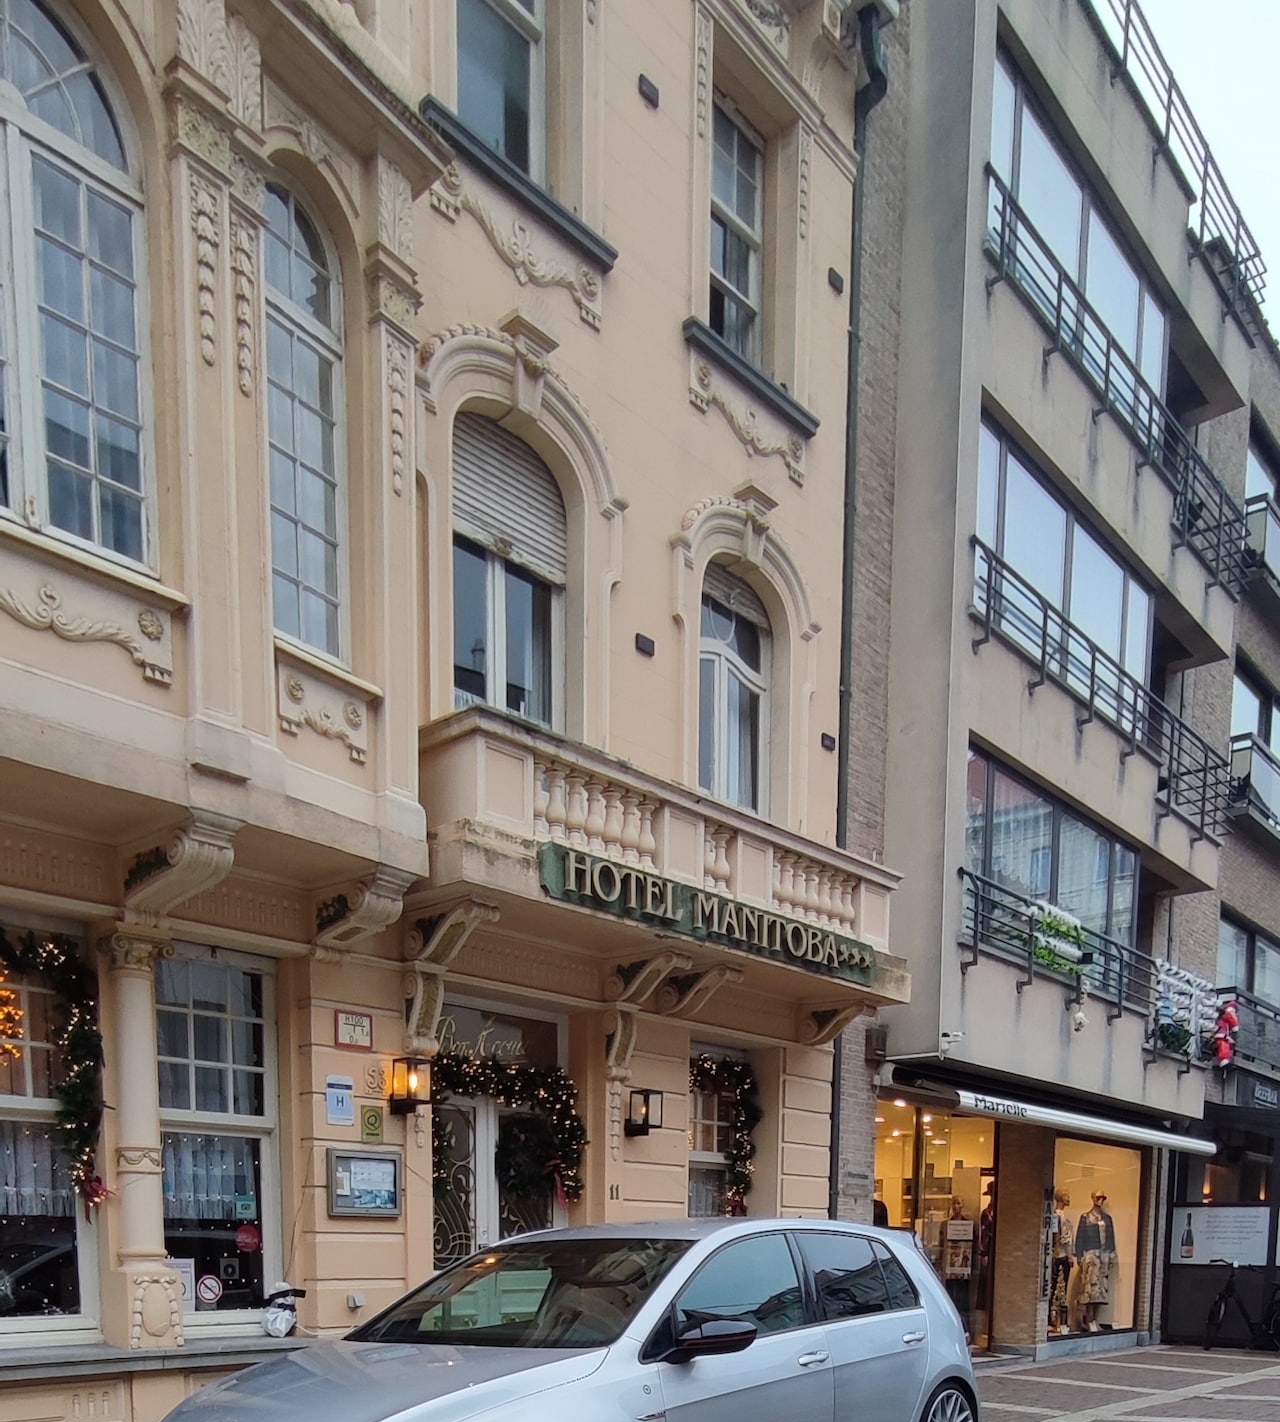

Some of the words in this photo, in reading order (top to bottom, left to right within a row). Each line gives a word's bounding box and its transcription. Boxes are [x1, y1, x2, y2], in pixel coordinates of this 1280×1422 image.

[564, 850, 683, 922] HOTEL
[693, 891, 840, 968] MANITOBA
[336, 1095, 344, 1107] H
[609, 1183, 620, 1200] 11
